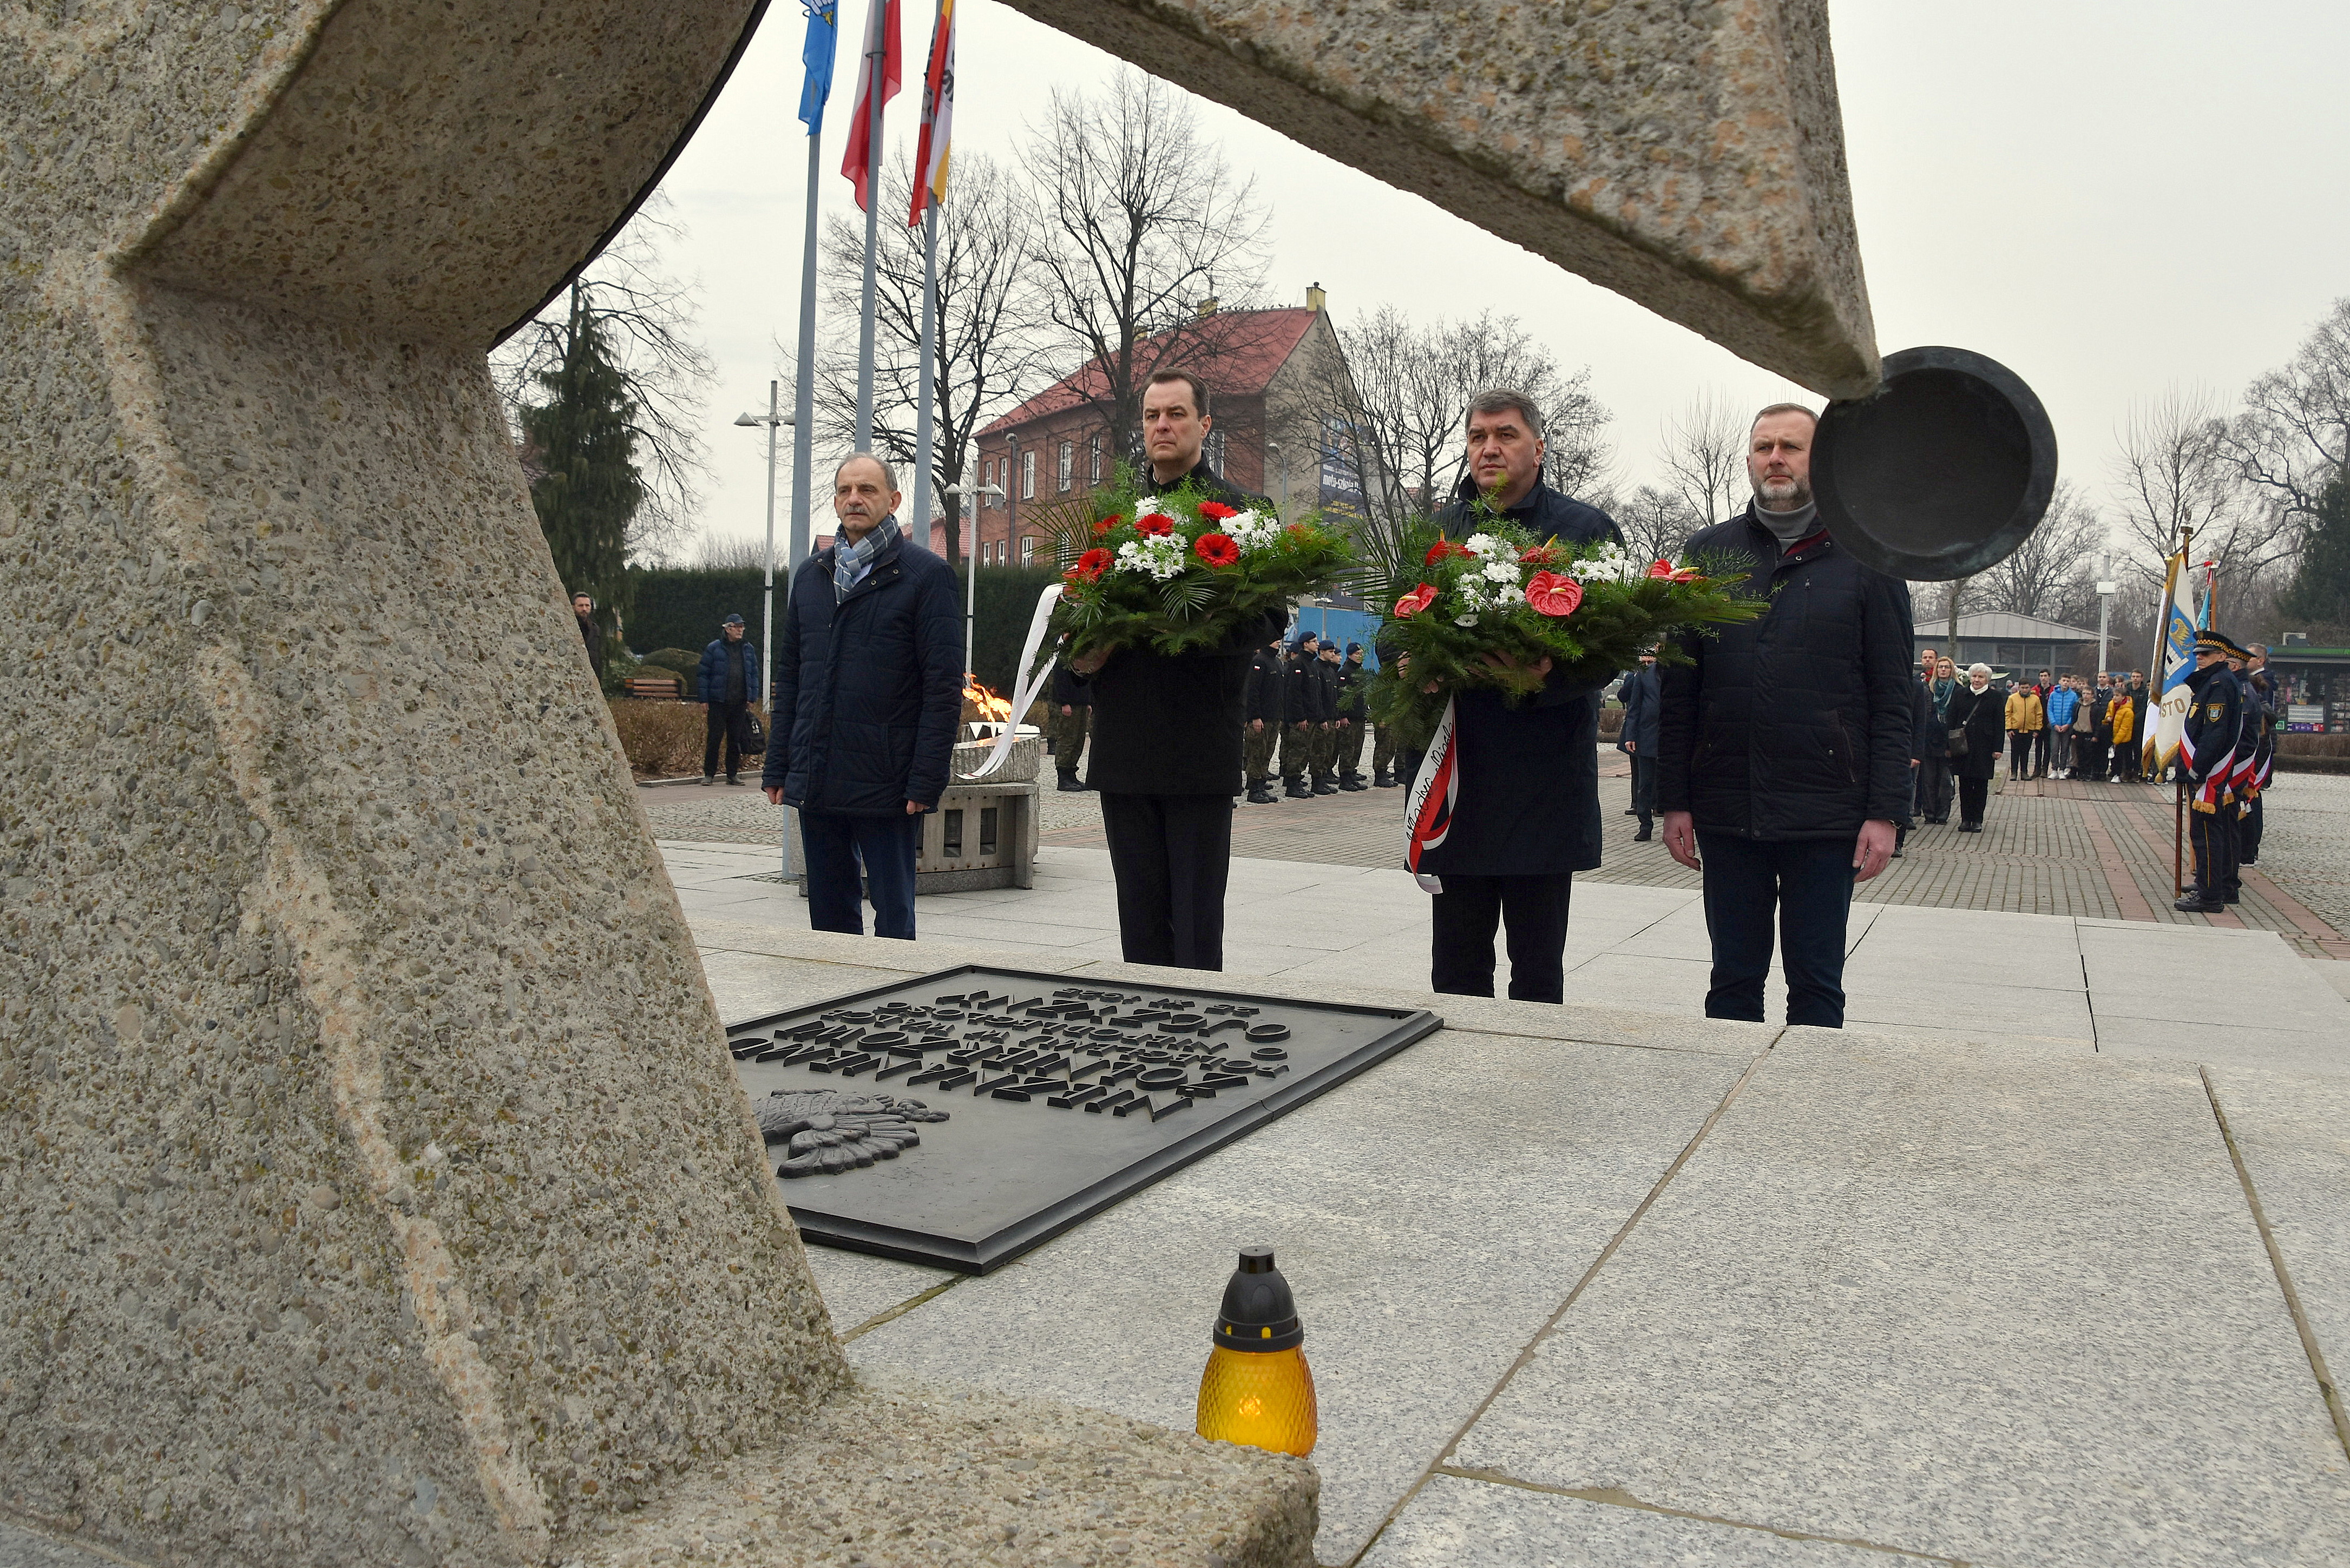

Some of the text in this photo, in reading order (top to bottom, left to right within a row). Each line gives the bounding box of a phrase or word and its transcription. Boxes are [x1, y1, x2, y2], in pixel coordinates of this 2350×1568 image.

[2159, 698, 2185, 718] STO
[820, 1009, 1290, 1078] POLEGŁEMU W WALCE
[935, 990, 1291, 1043] OJCZYZNY
[729, 1037, 1193, 1122] NIEZNANEMU
[774, 1020, 1249, 1097] ŻOŁNIERZOWI
[1251, 1047, 1288, 1061] O
